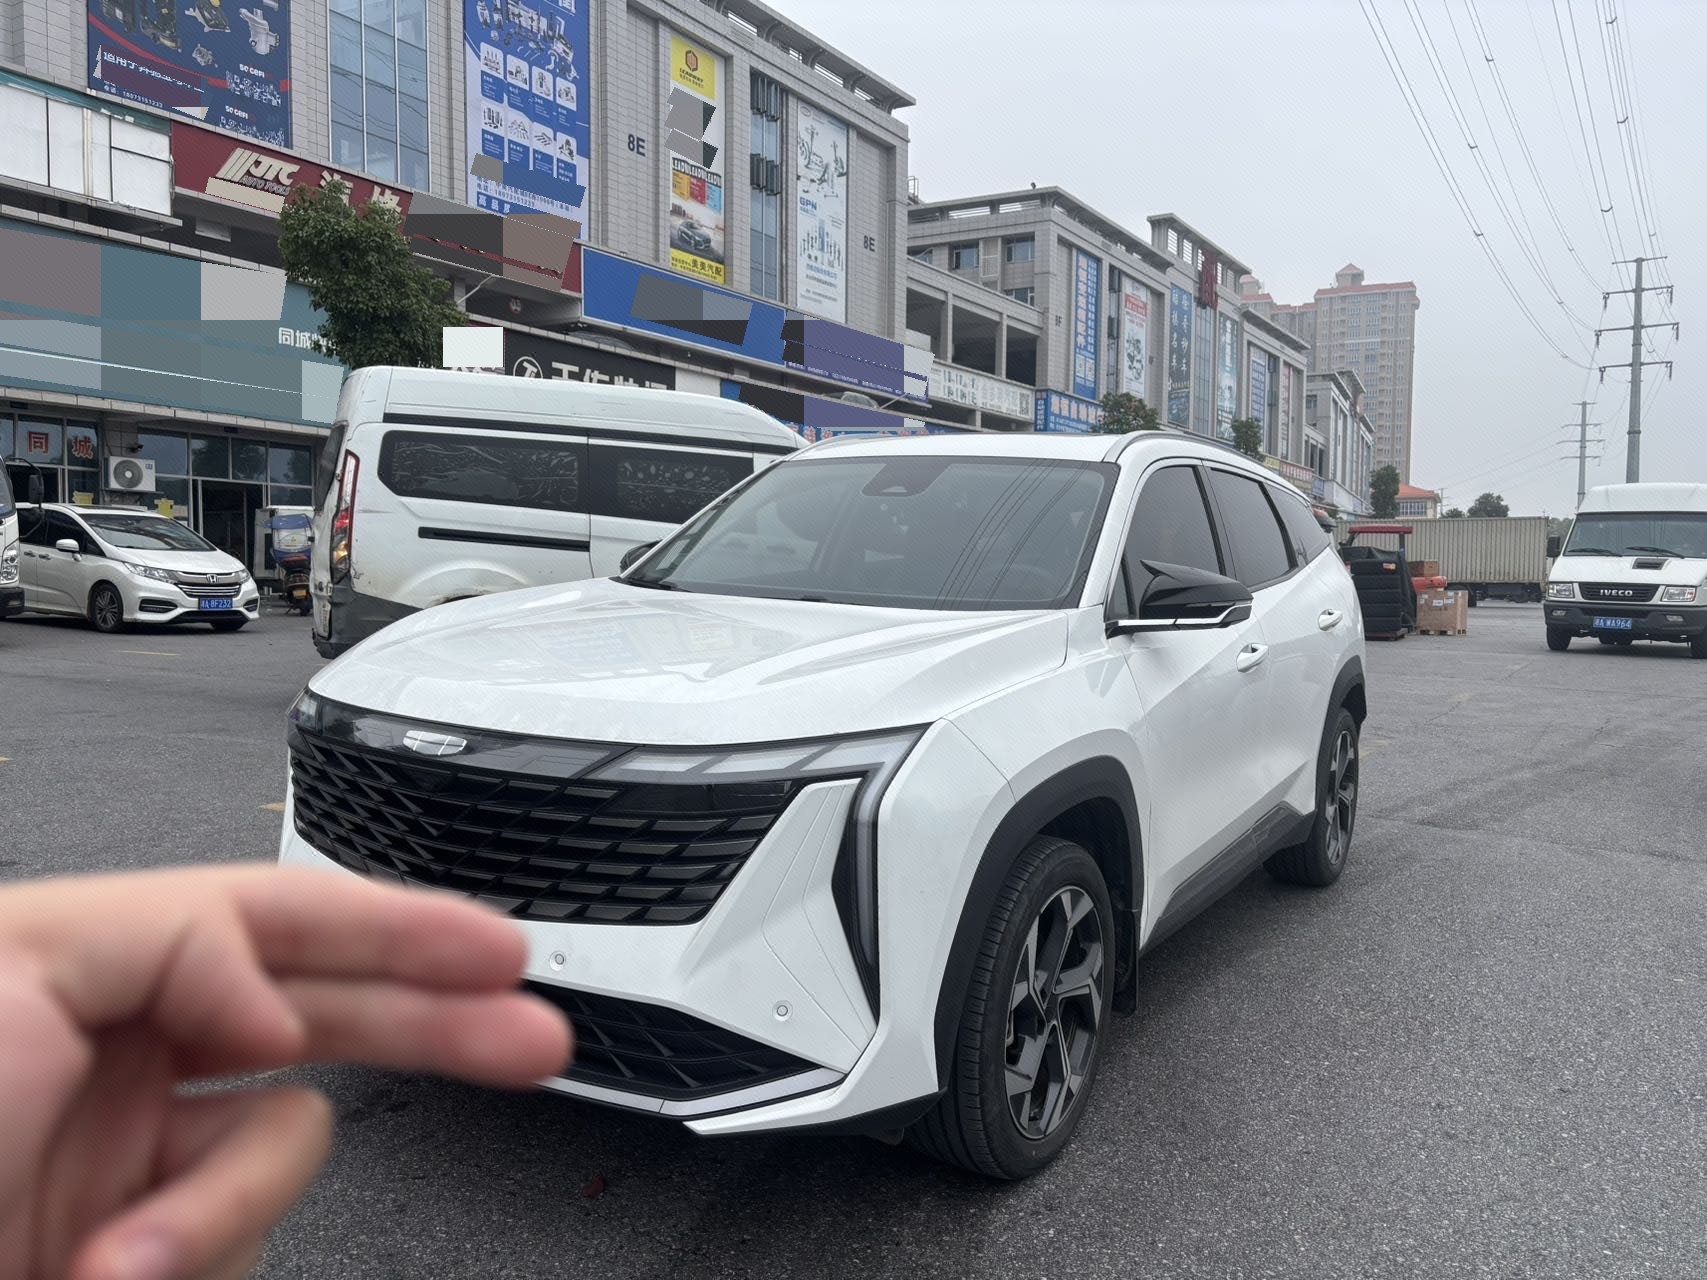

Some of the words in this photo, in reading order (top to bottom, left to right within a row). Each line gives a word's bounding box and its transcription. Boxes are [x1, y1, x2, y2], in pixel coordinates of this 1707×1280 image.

[627, 133, 646, 157] 8E
[241, 174, 265, 190] AUTO
[264, 181, 290, 196] TOOLS
[863, 235, 876, 252] 8E
[1600, 589, 1633, 597] IVECO
